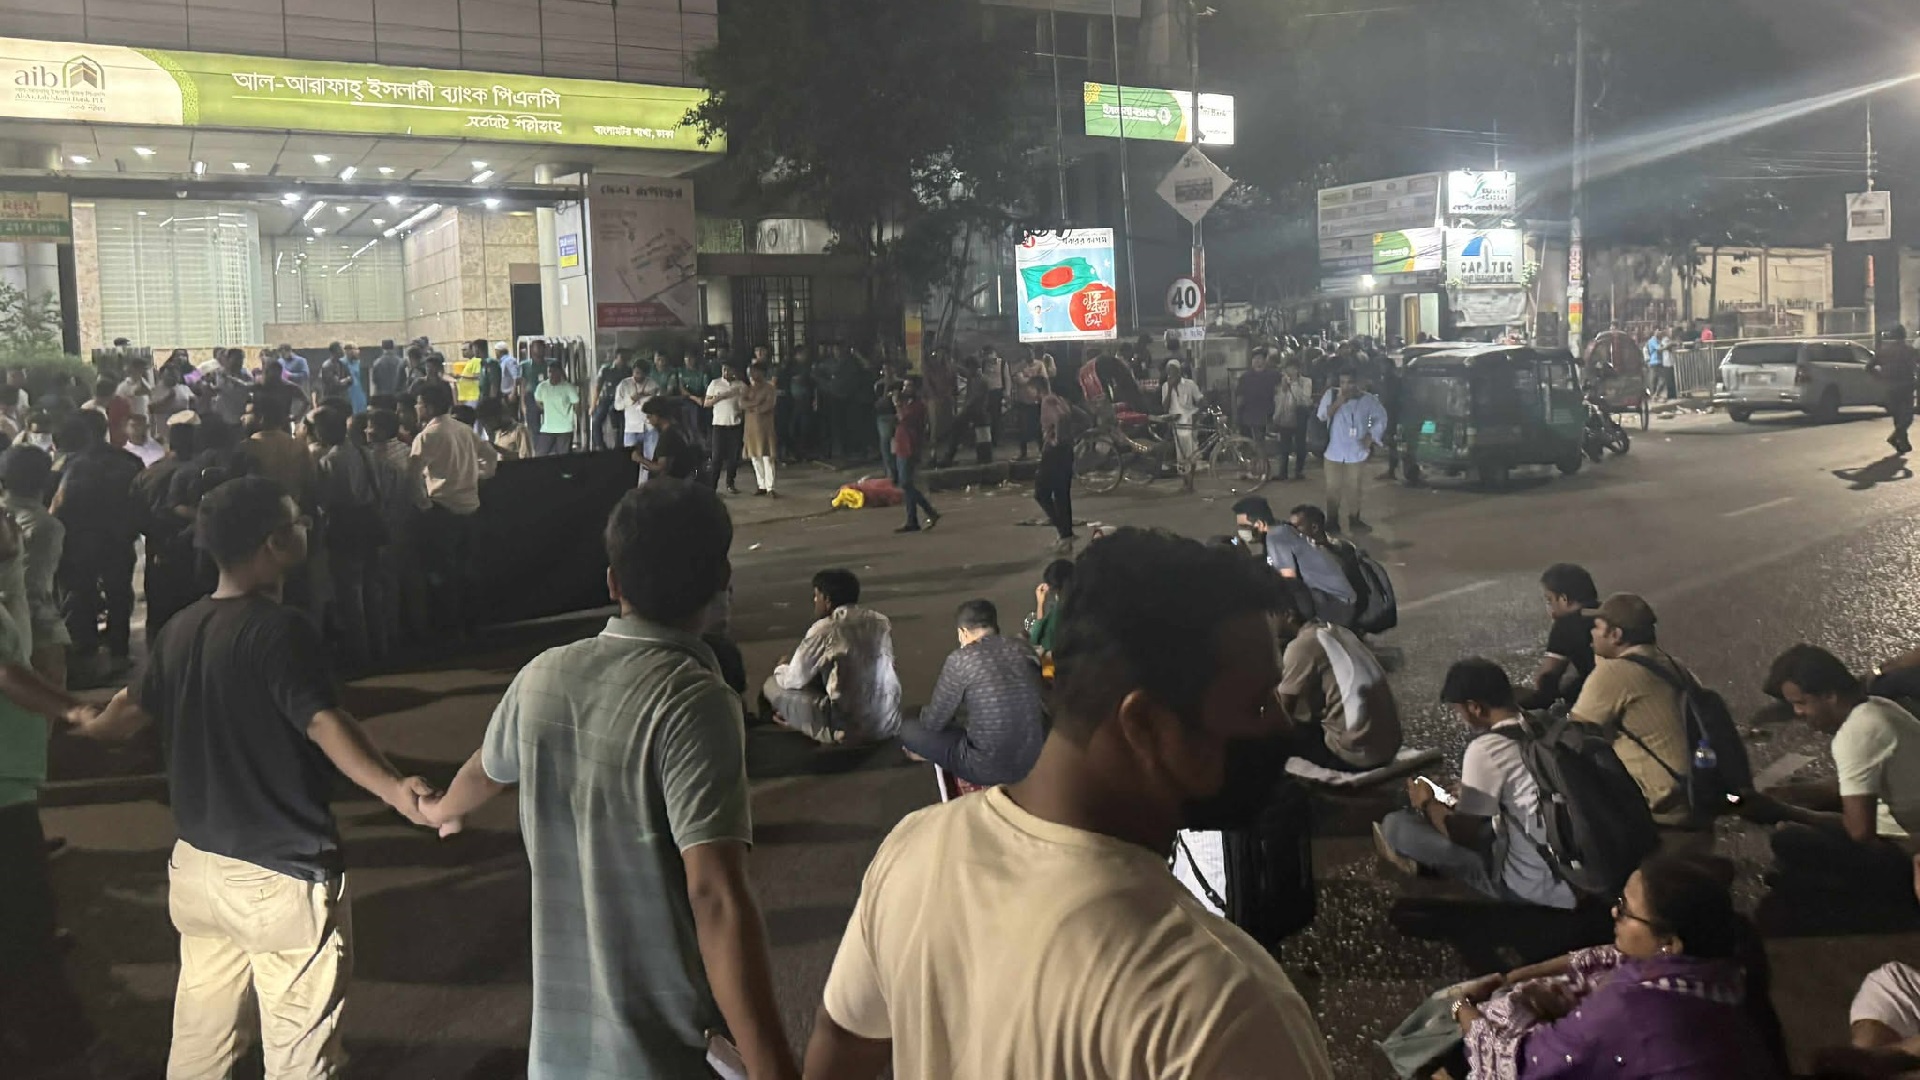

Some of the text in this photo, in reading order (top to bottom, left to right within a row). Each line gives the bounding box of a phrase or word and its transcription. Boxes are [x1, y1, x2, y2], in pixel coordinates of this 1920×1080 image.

[15, 65, 58, 87] aib
[232, 72, 562, 109] আল-আরাফাহ্ ইসলামী ব্যাংক পিএলসি
[465, 114, 510, 130] সর্বদাই
[1171, 285, 1197, 309] 40
